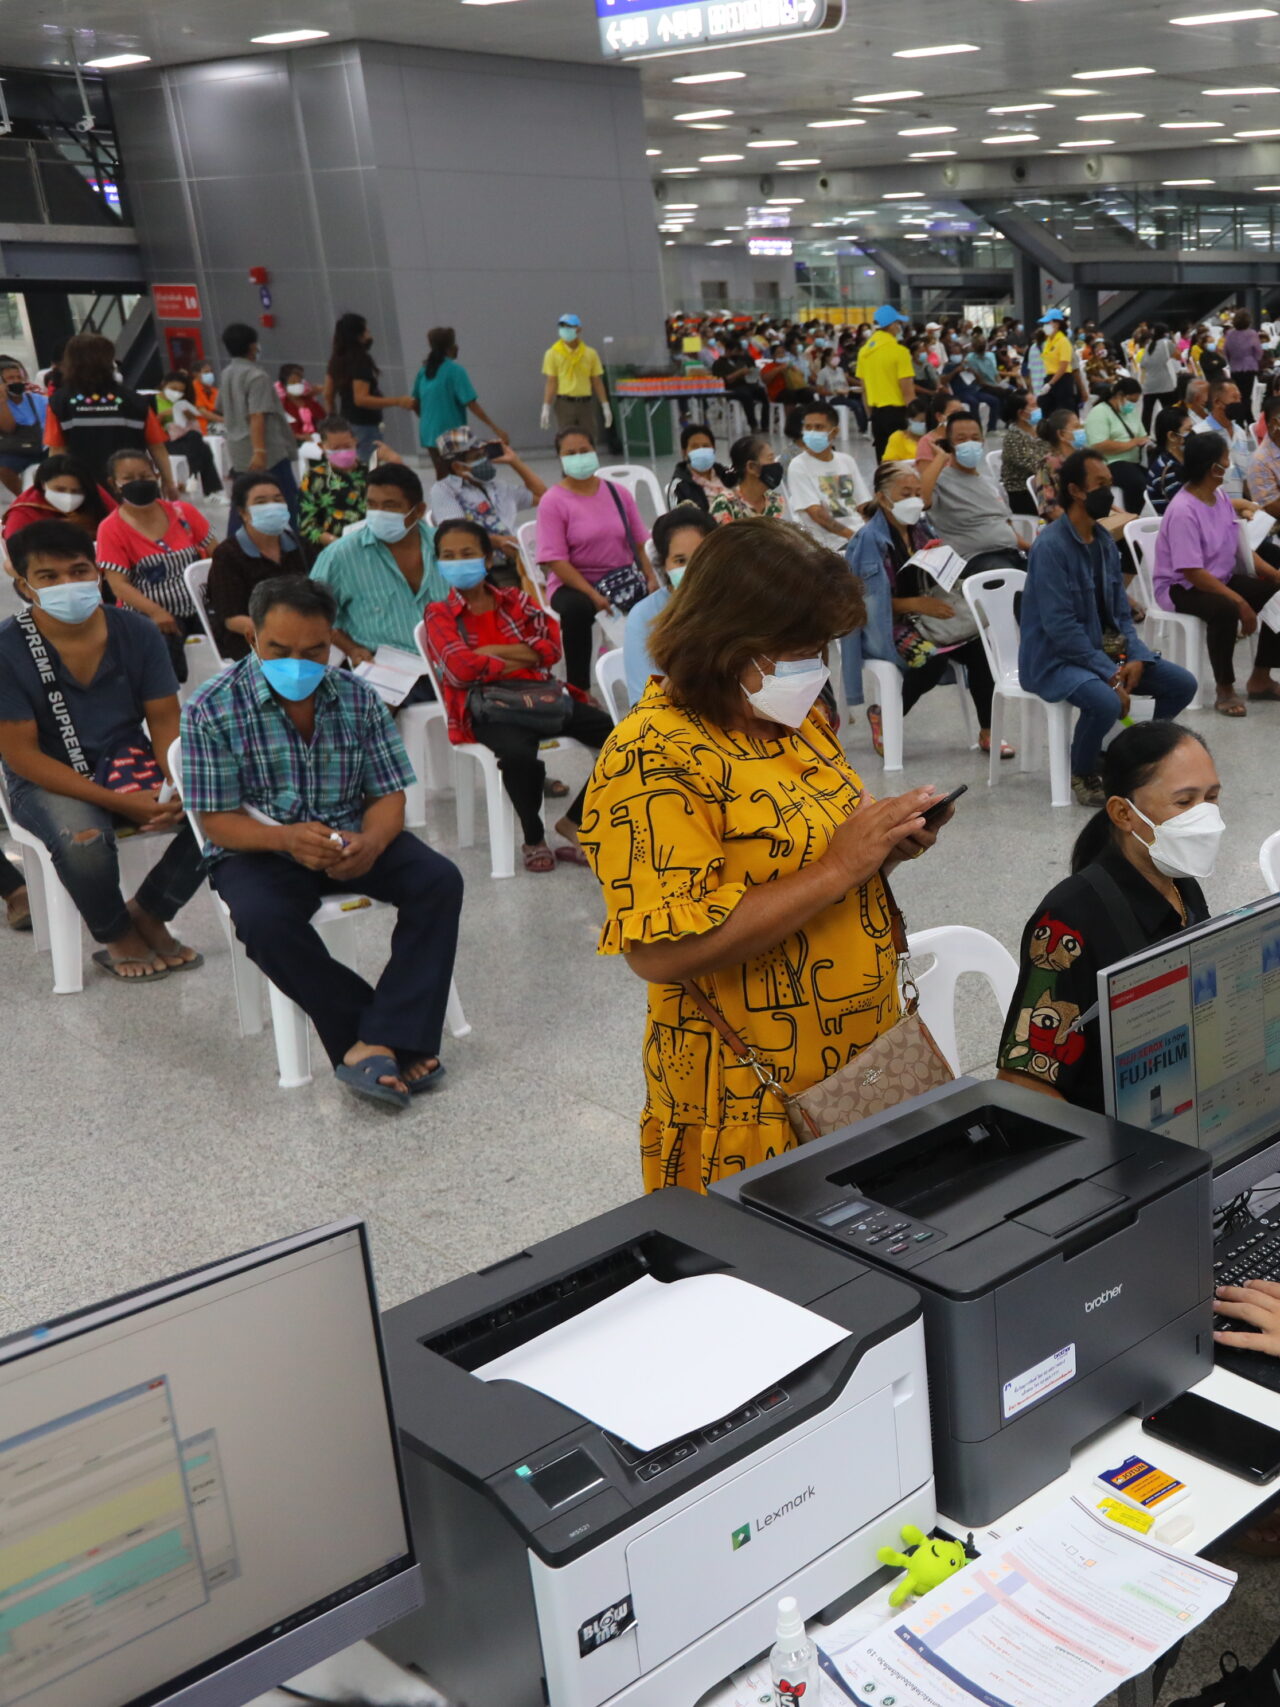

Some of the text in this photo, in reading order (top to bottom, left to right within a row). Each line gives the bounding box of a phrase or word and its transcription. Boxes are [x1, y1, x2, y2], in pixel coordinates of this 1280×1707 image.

[15, 607, 56, 684] SUPREME
[48, 690, 89, 776] SUPREME
[1119, 1042, 1188, 1089] FUJIFILM
[1084, 1283, 1123, 1313] brother
[1121, 1463, 1146, 1480] JOTUN
[756, 1485, 816, 1532] Lexmark
[583, 1602, 628, 1641] BLOW
